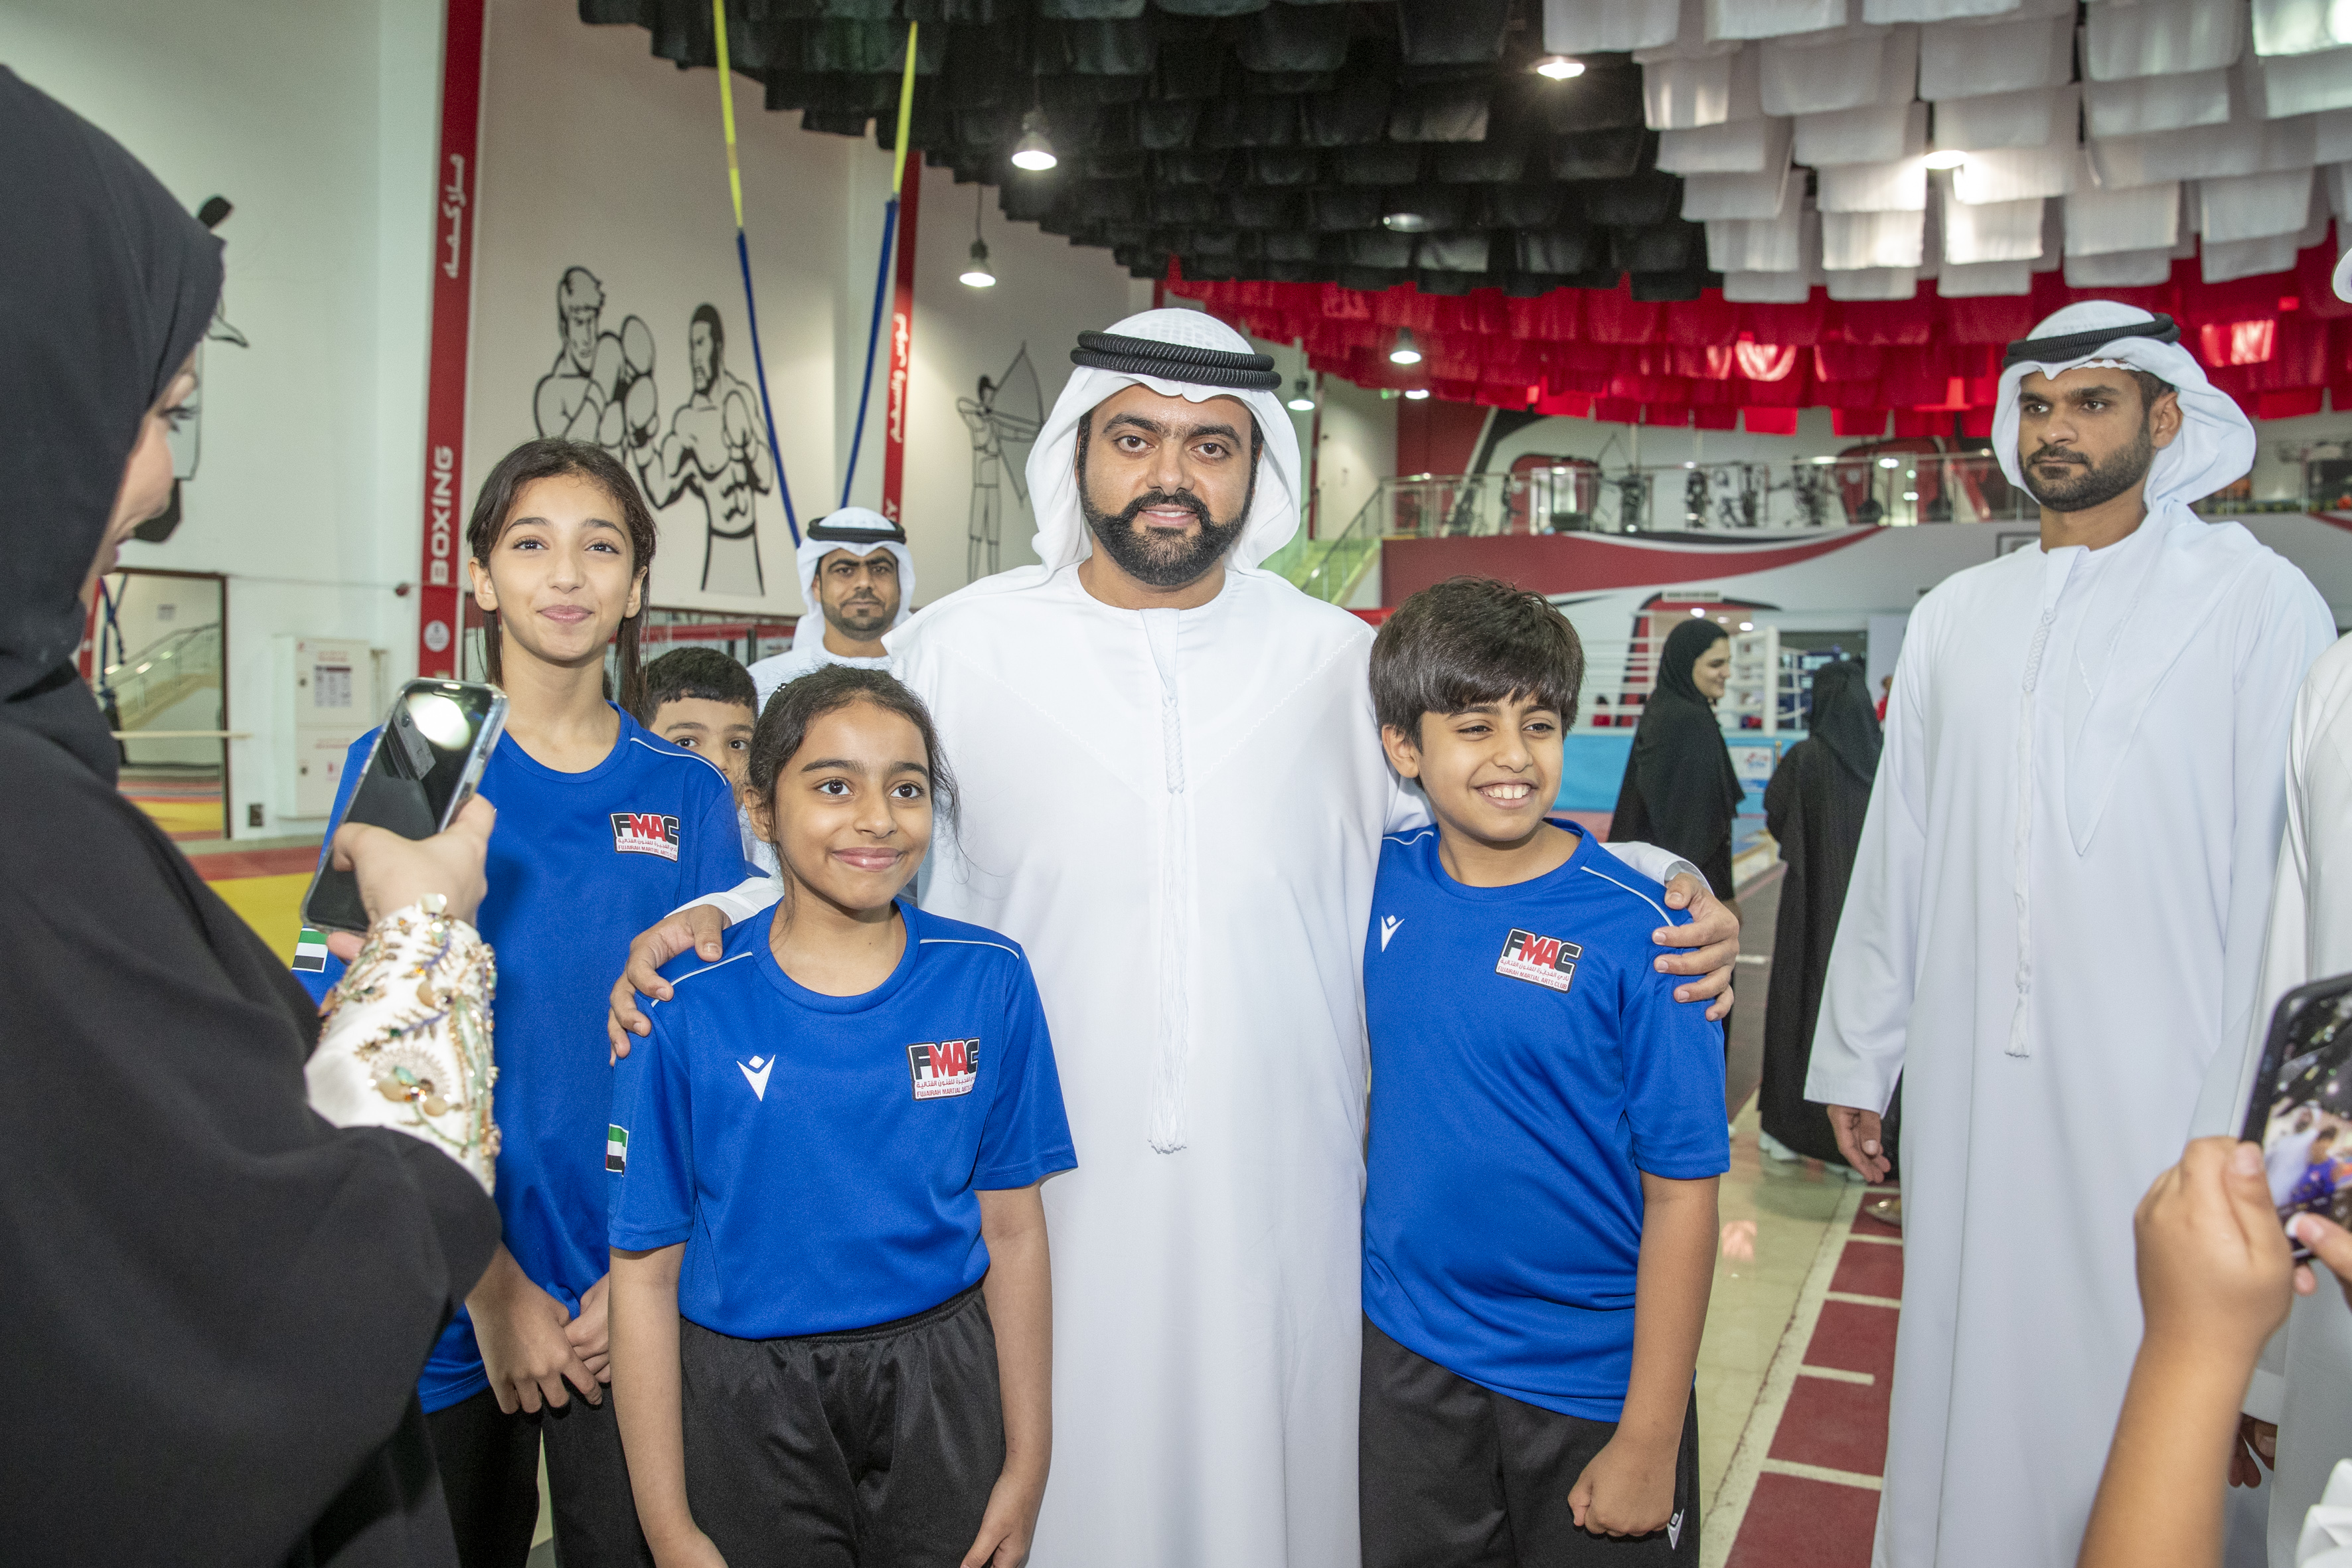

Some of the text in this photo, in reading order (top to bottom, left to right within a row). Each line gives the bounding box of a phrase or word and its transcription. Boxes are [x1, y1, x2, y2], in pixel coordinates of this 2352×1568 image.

[430, 445, 453, 586] BOXING
[613, 815, 678, 845] FMAC
[1500, 958, 1519, 967] القتالية
[1502, 930, 1580, 975] FMAC
[1498, 966, 1567, 990] FUJAIRAH MARTIAL ARTS CLUB
[1519, 963, 1536, 972] للفنون
[1537, 968, 1557, 978] الفجيرة
[910, 1041, 979, 1080] FMAC
[916, 1081, 937, 1089] القتالية
